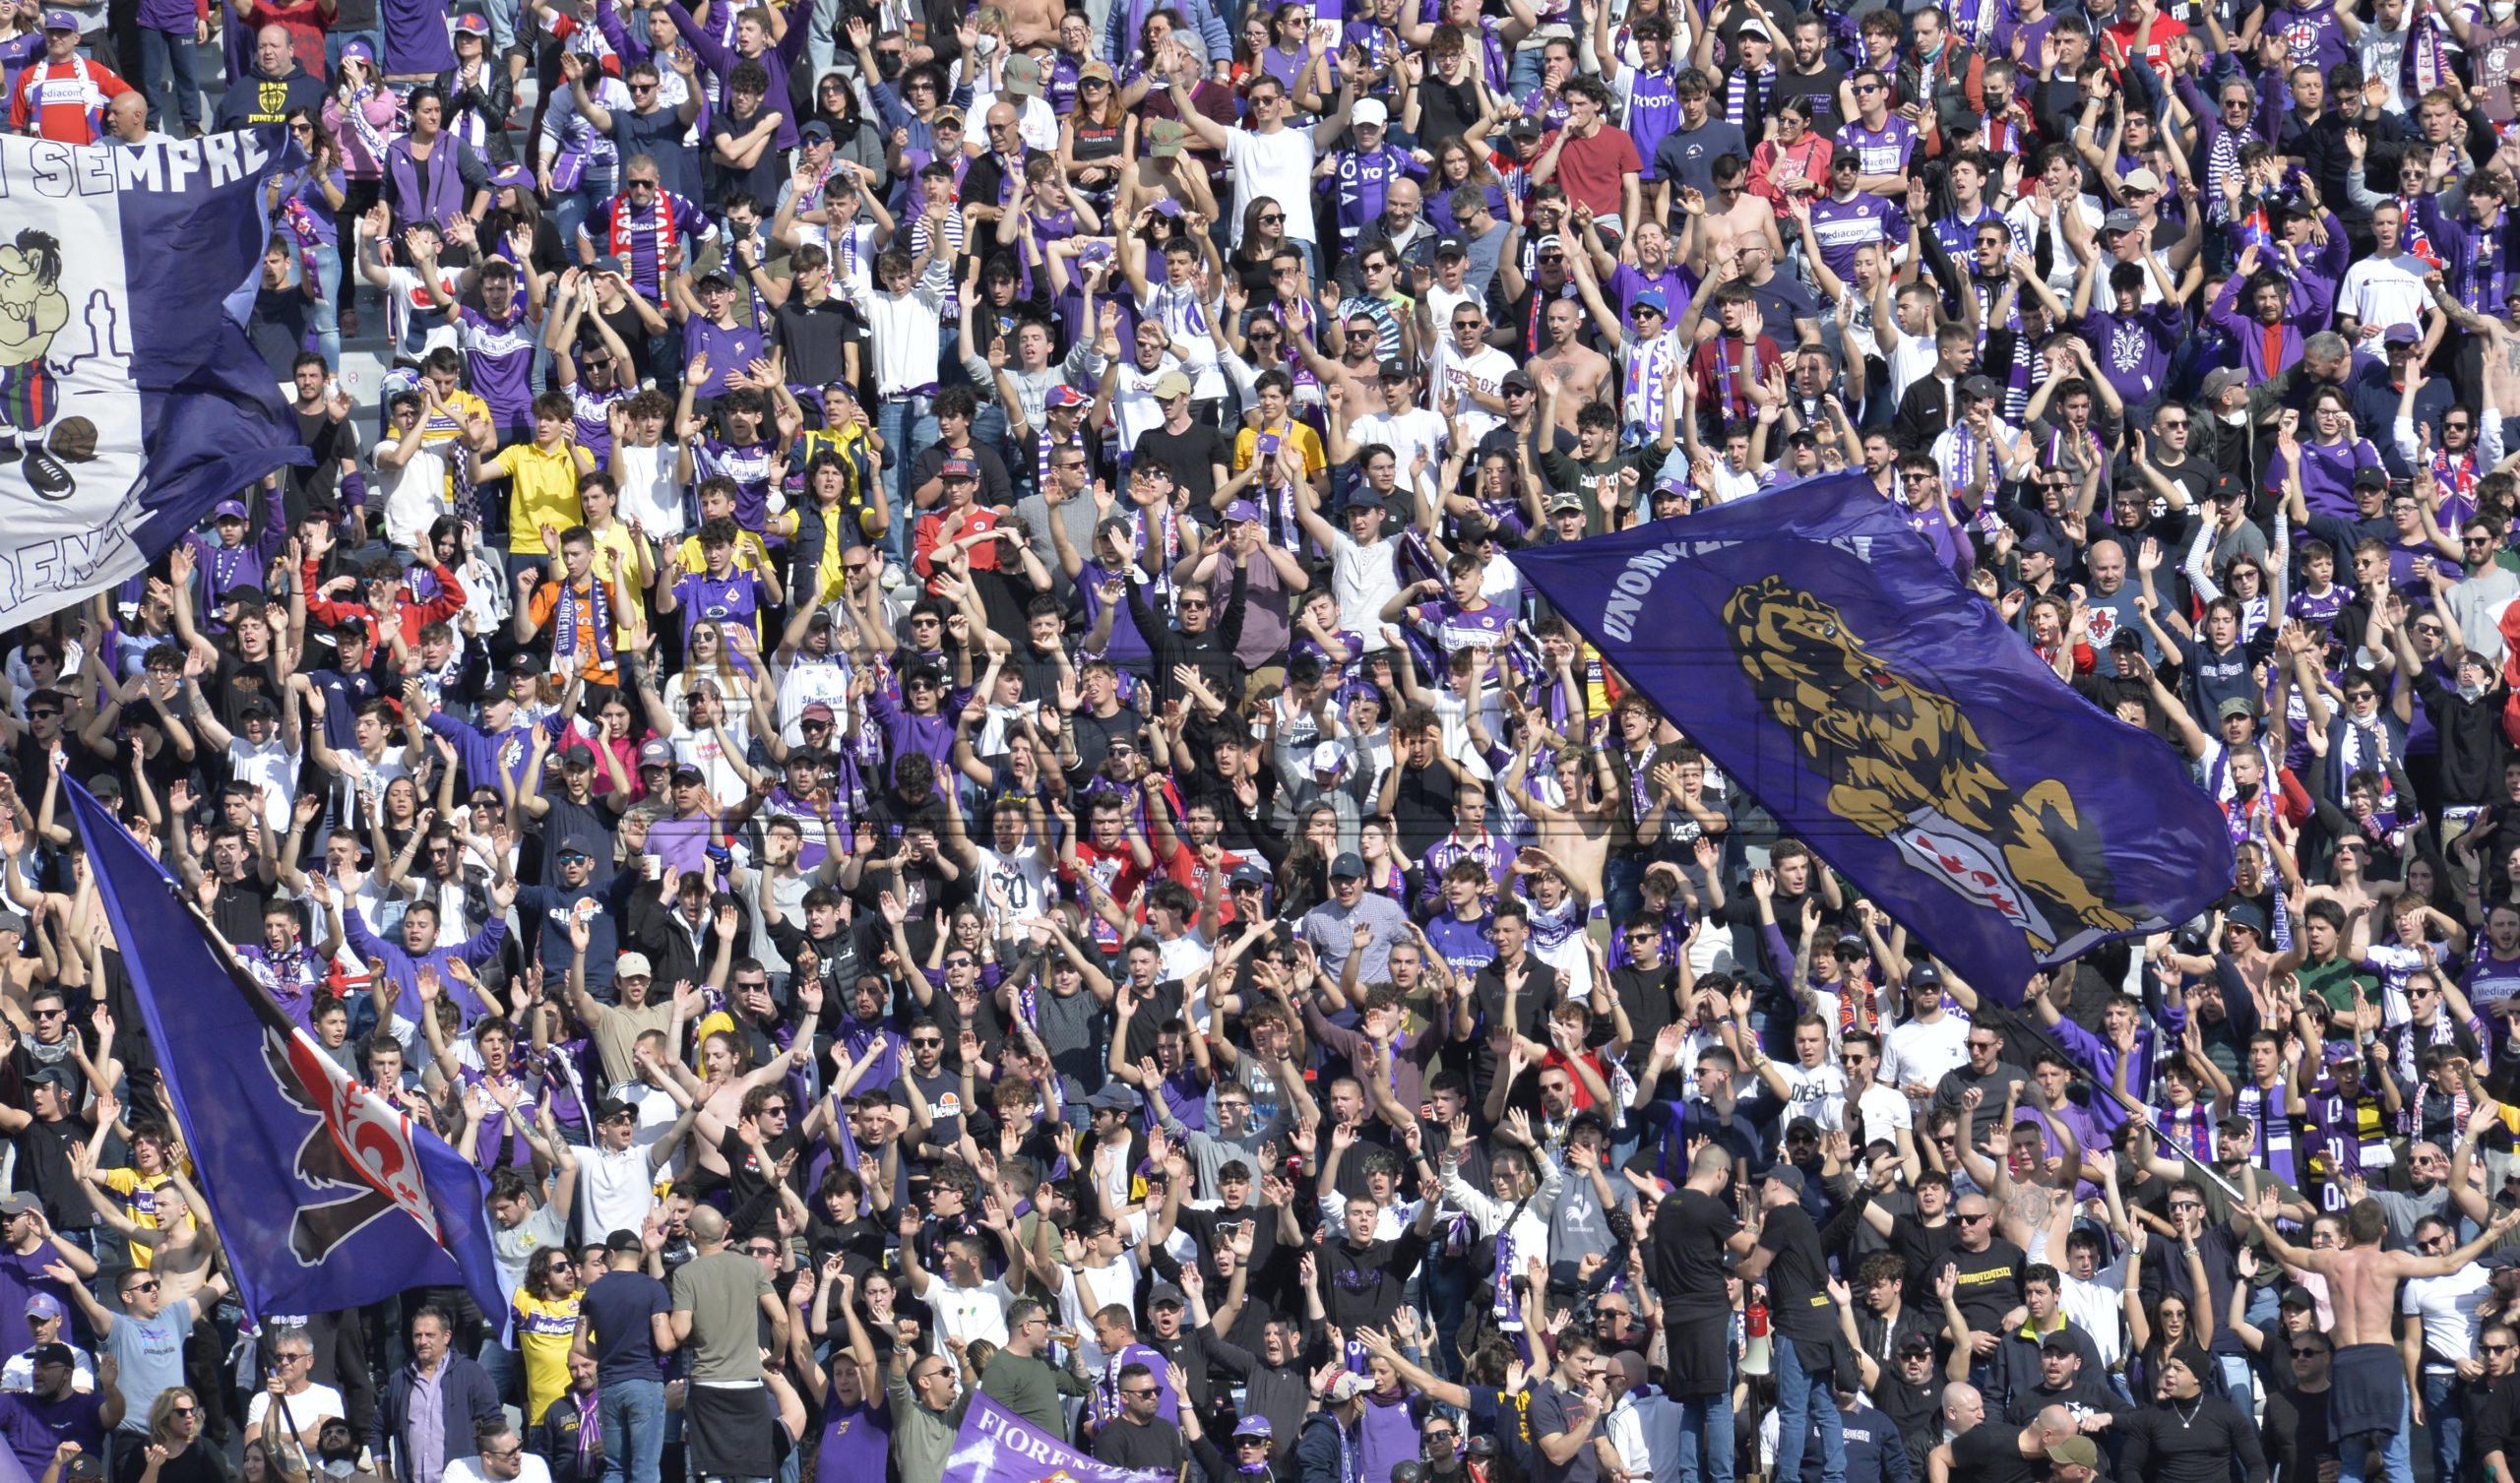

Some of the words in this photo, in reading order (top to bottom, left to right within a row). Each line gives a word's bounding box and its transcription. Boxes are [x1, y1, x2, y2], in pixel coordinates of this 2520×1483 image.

[41, 88, 83, 100] ediacom
[1633, 93, 1675, 108] TOYOTA
[32, 131, 269, 199] SEMPRE
[1820, 228, 1865, 242] Mediacom
[1791, 1079, 1829, 1103] DIESEL
[536, 1320, 577, 1334] Mediaco
